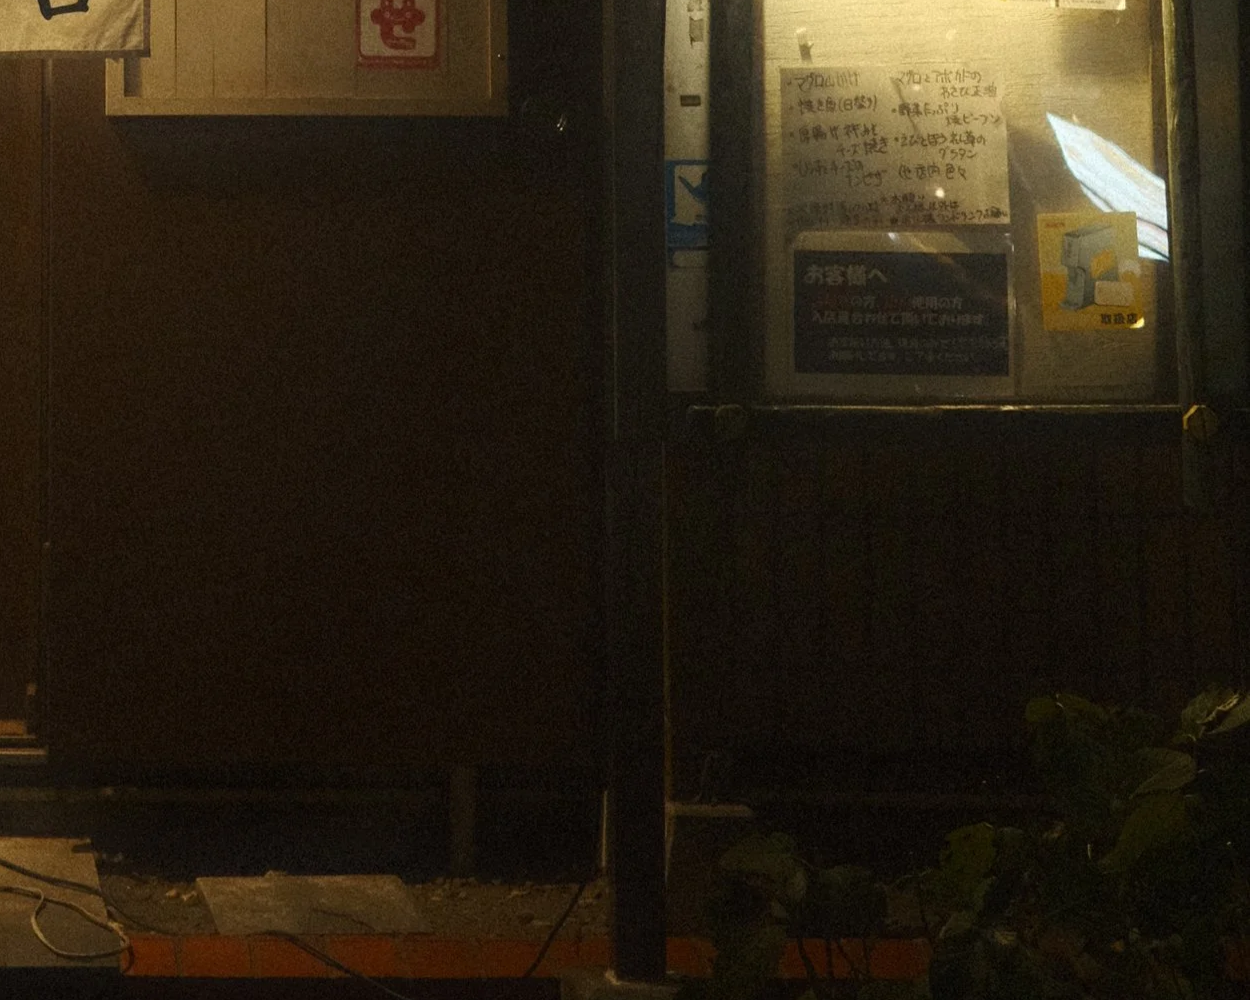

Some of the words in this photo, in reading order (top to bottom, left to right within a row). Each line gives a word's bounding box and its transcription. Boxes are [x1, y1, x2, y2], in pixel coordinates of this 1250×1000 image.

[938, 147, 978, 161] グラタン
[803, 263, 889, 287] お客様へ
